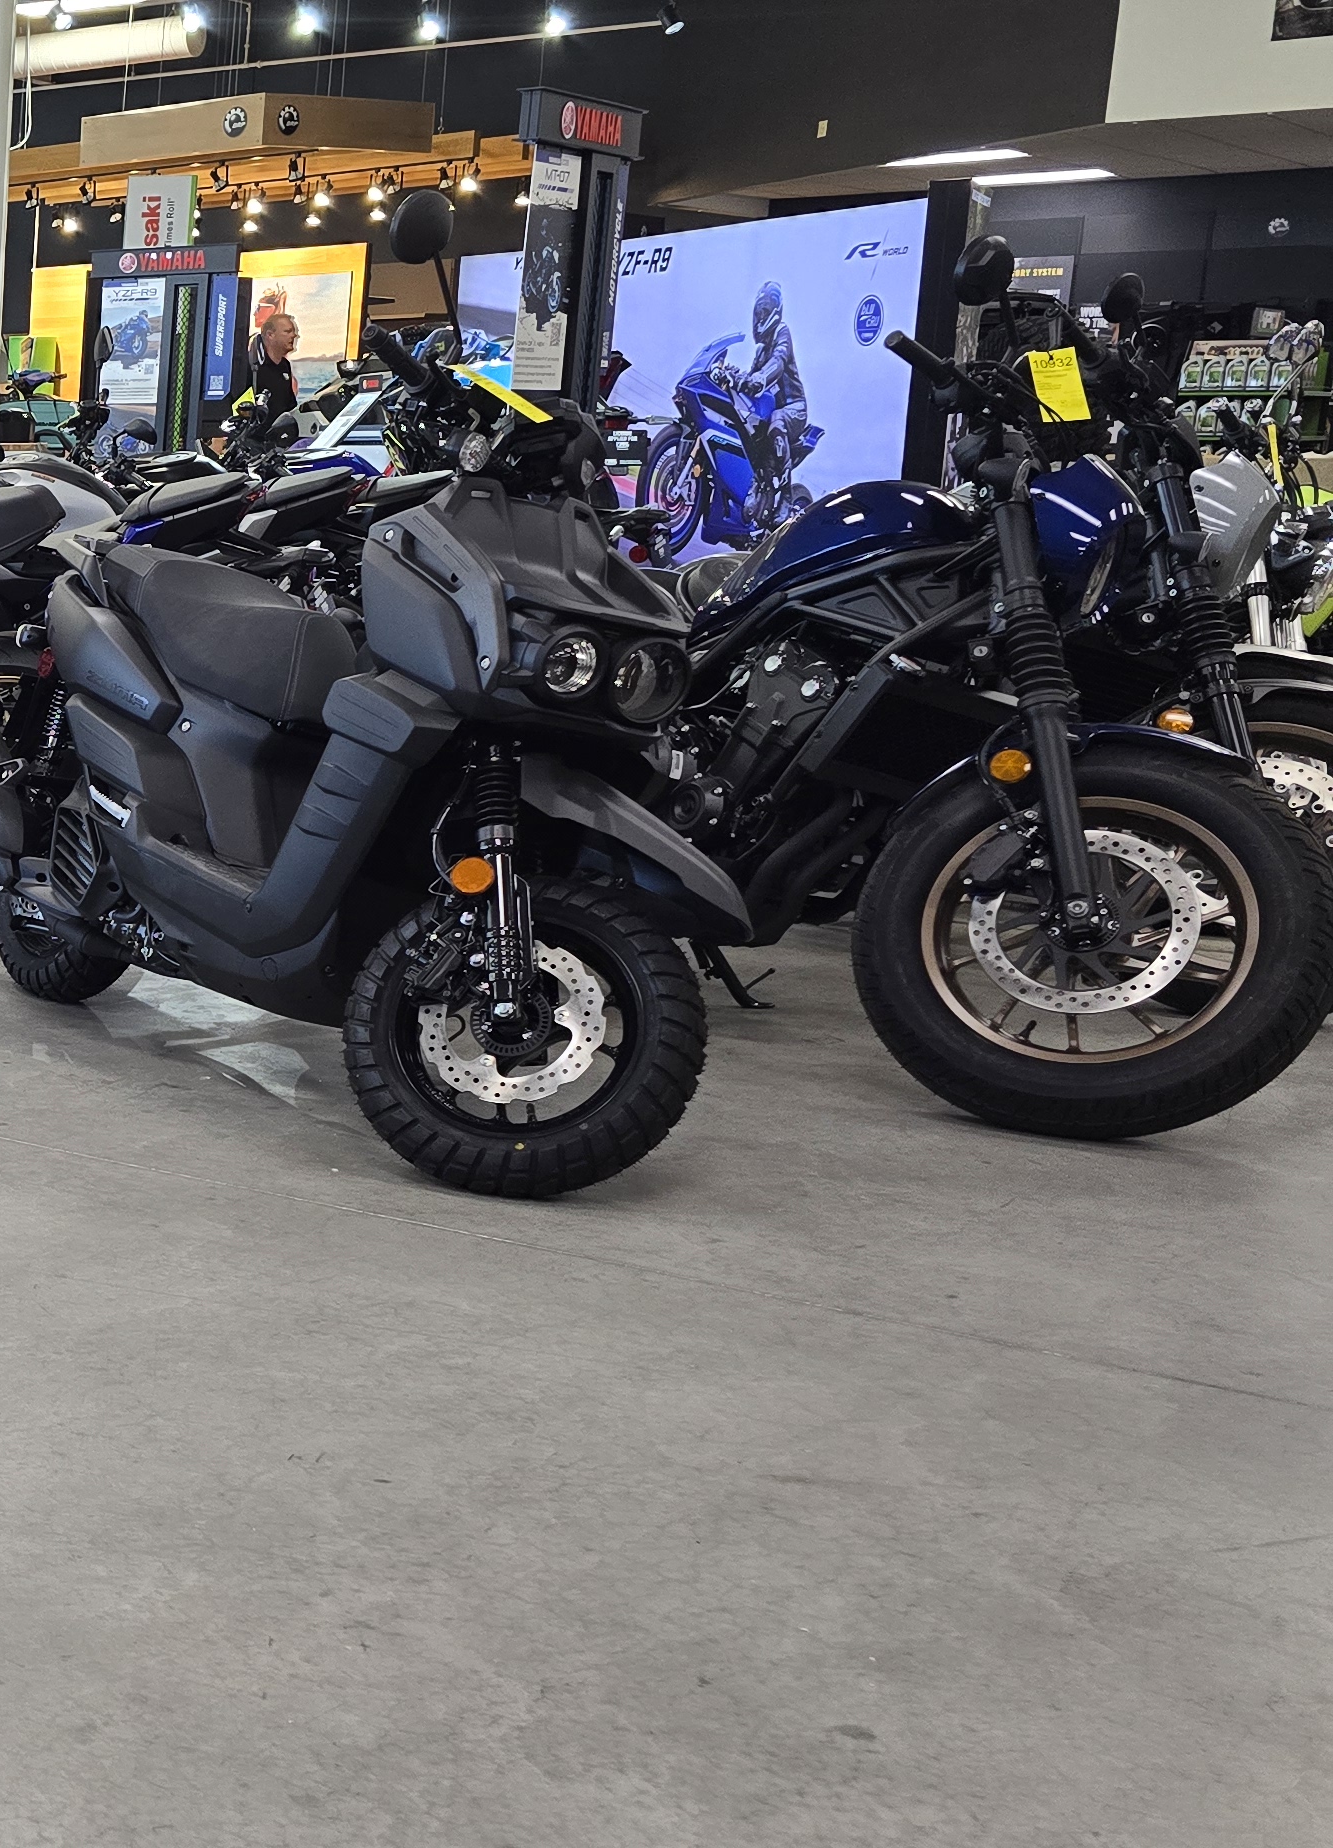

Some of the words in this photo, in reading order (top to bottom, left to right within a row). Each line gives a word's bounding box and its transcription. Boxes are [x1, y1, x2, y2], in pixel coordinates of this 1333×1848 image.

[576, 105, 623, 147] YAMAHA
[545, 168, 570, 183] MT-07
[141, 196, 162, 247] saki
[608, 198, 625, 306] MOTORCYCLE
[882, 246, 909, 256] WORLD
[139, 250, 205, 272] YAMAHA
[1033, 267, 1064, 276] SYSTEM
[113, 288, 157, 298] YZF-R9
[1080, 306, 1103, 317] WOR
[214, 294, 228, 357] SUPERSPORT
[1032, 356, 1073, 369] 10932
